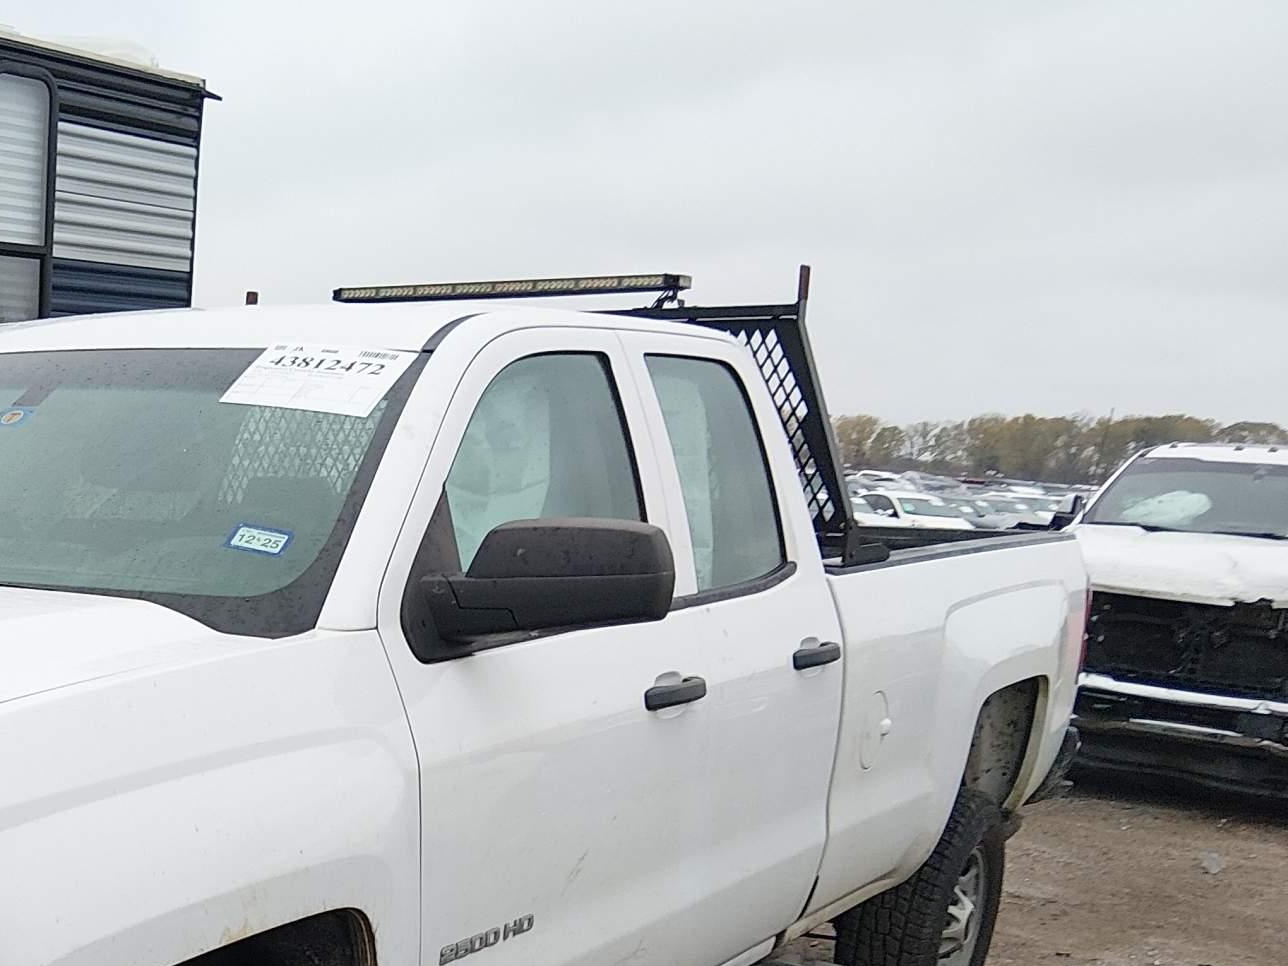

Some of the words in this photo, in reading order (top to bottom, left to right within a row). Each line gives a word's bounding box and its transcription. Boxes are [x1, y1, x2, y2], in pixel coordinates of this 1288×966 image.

[270, 354, 385, 375] 43812472
[439, 926, 500, 966] 2500
[503, 913, 534, 941] HD
